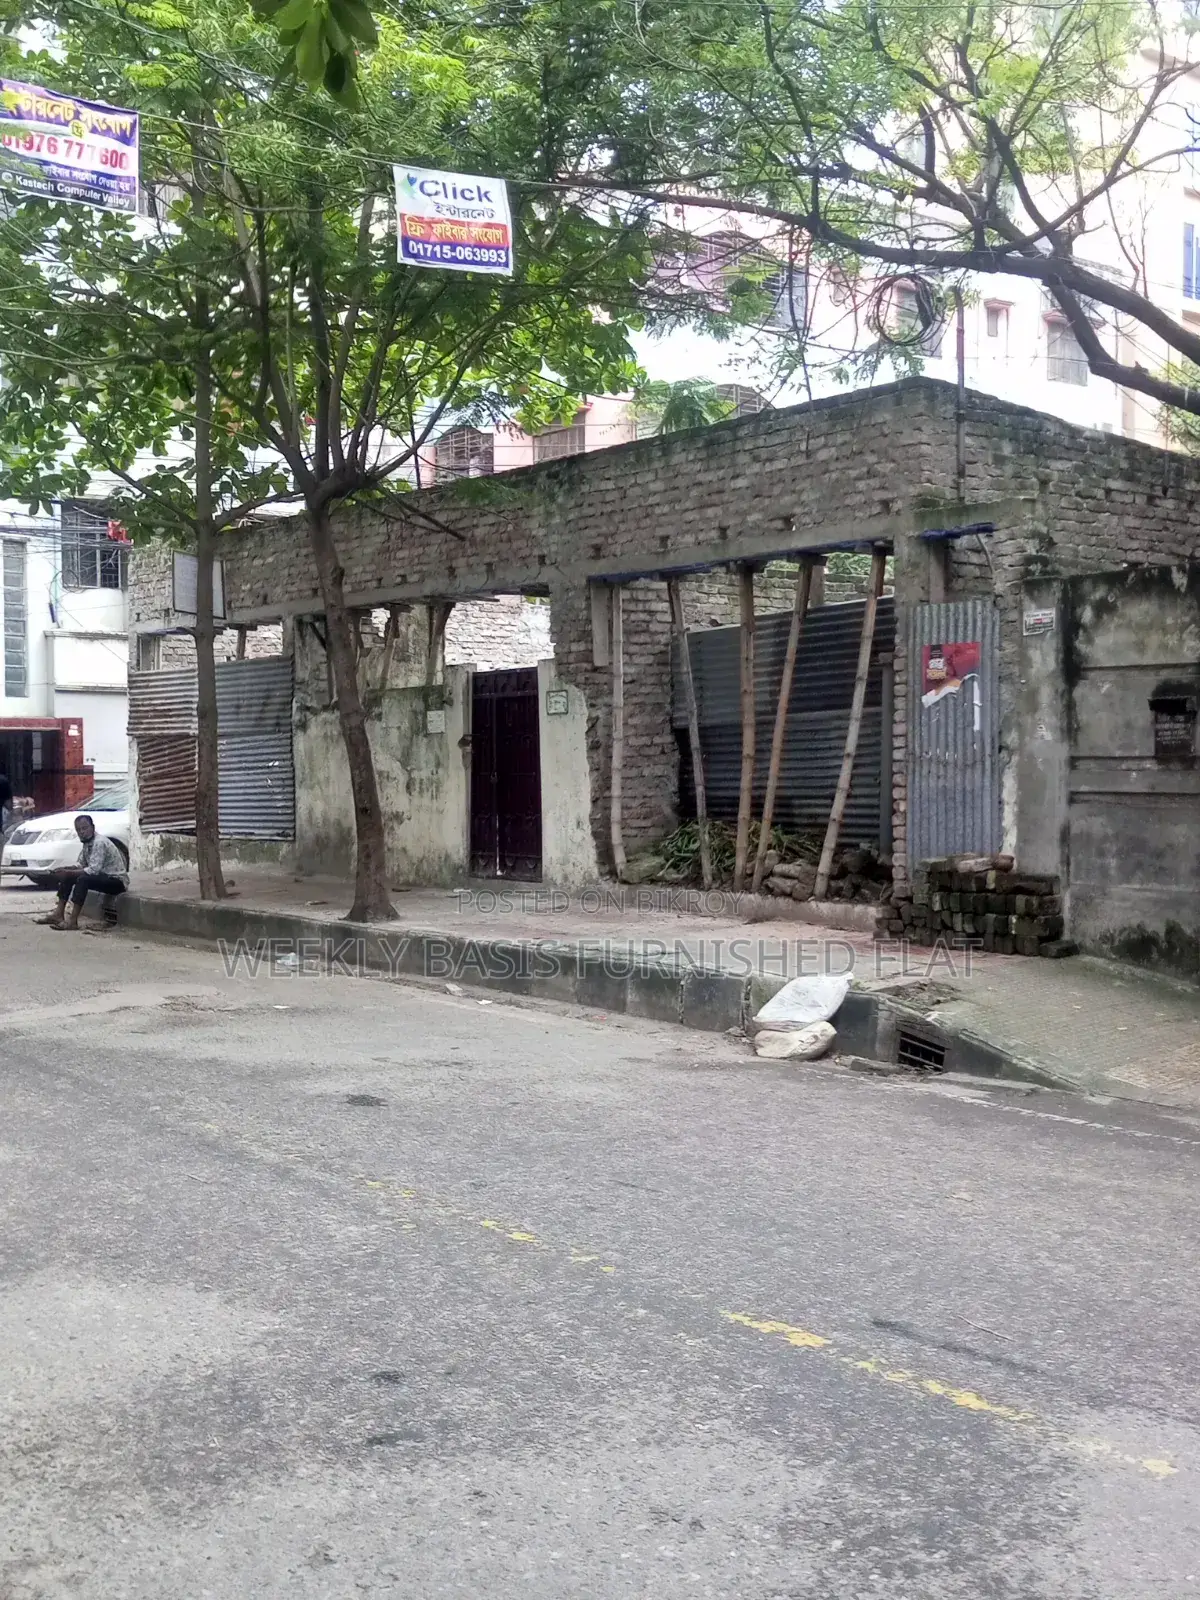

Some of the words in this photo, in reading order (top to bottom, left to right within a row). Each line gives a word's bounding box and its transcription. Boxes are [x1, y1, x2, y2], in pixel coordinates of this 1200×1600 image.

[57, 184, 101, 201] Computer
[102, 193, 130, 208] Valley
[419, 180, 493, 203] Click
[433, 200, 496, 219] ইন্টারনেট
[431, 219, 468, 241] ফাইবার
[409, 240, 506, 263] 01715-063993
